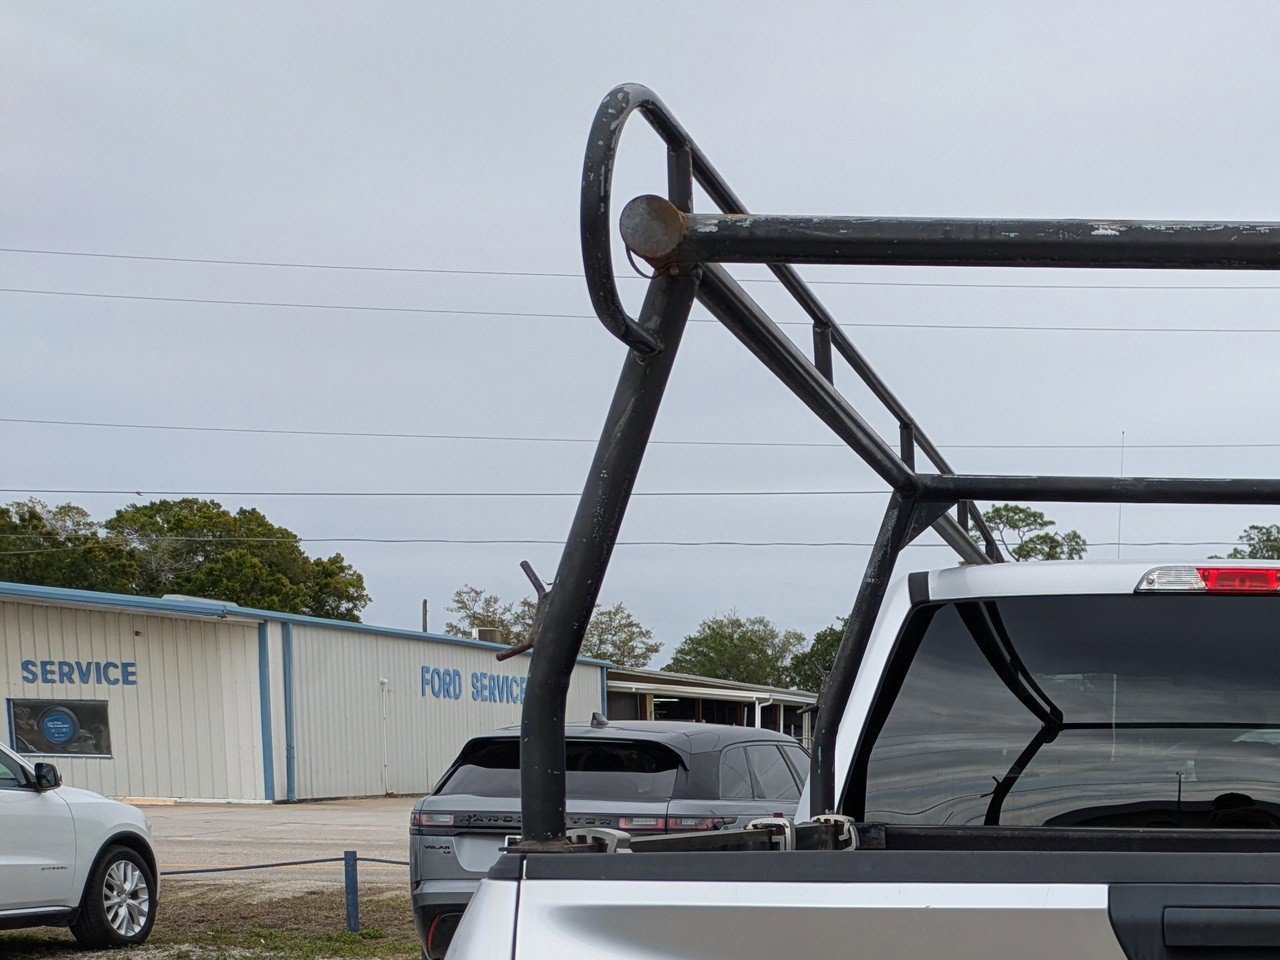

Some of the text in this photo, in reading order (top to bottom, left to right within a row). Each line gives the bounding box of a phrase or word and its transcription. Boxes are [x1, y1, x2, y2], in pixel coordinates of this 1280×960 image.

[20, 659, 138, 686] SERVICE
[421, 665, 529, 704] FORD SERVICE
